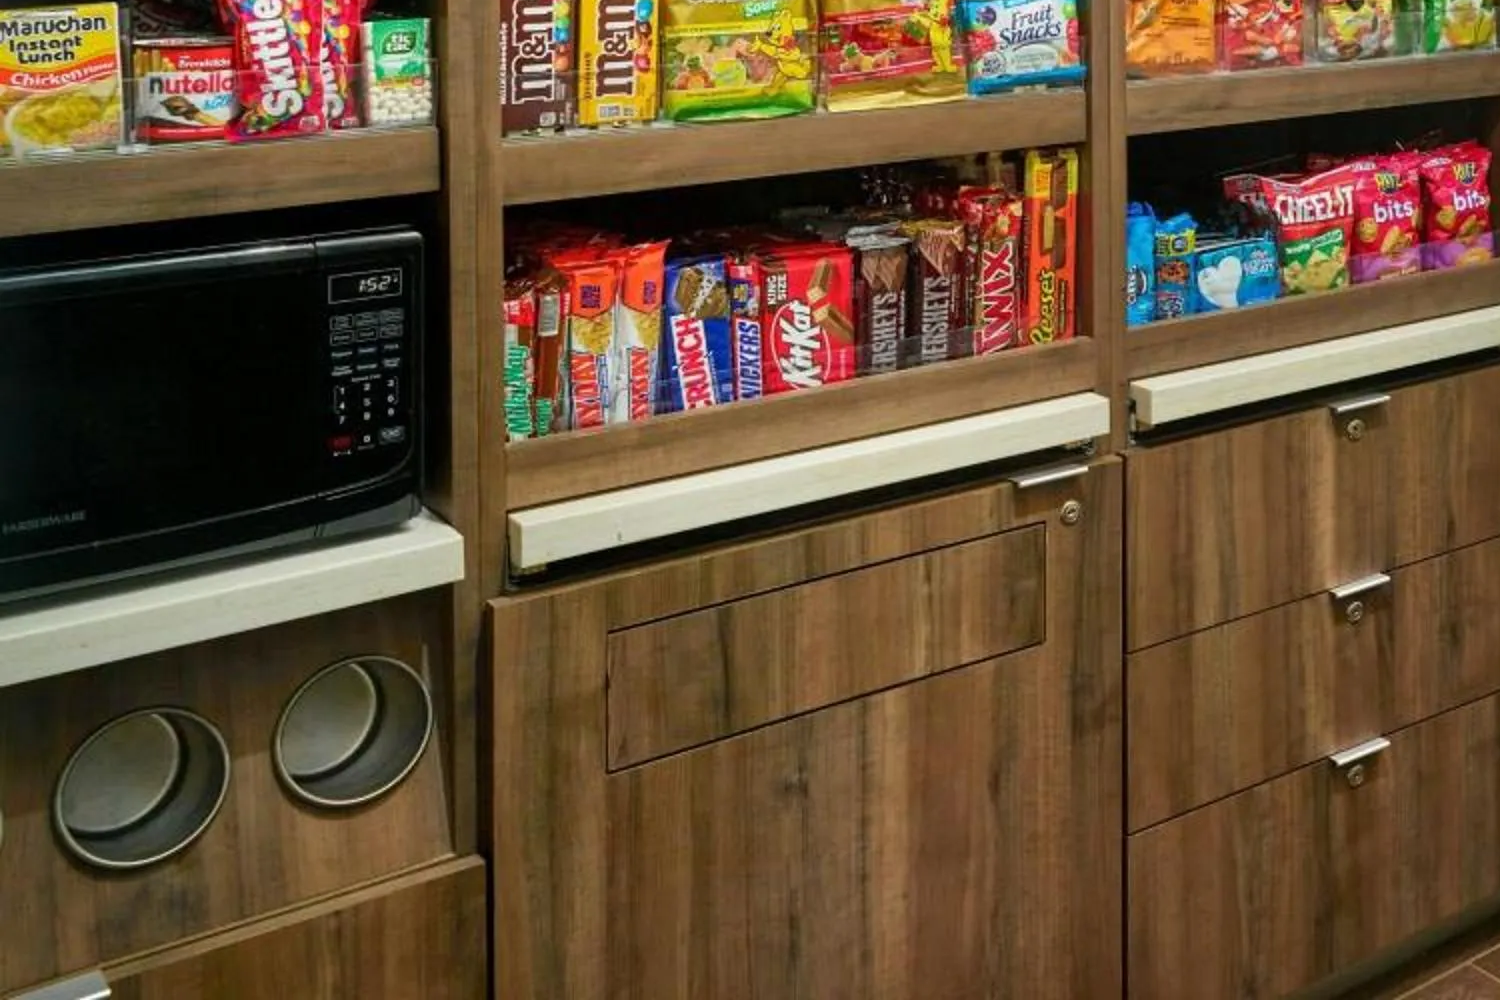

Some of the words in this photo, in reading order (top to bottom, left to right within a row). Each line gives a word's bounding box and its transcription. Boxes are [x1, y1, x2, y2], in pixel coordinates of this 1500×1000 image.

[0, 14, 107, 41] Maruchan
[1010, 2, 1054, 30] Fruit
[9, 35, 83, 53] Instant
[1000, 20, 1062, 46] Snacks
[18, 50, 76, 65] Lunch
[10, 69, 83, 88] Chicken
[150, 72, 235, 96] nutella
[1274, 184, 1355, 225] CHEEZ-IT
[1374, 199, 1414, 223] bits
[1452, 189, 1487, 212] bits
[766, 275, 777, 306] KING
[975, 241, 1015, 357] TWIX
[871, 289, 899, 373] ERSHEY'S
[737, 321, 762, 400] NICKERS
[571, 353, 605, 427] YDAY
